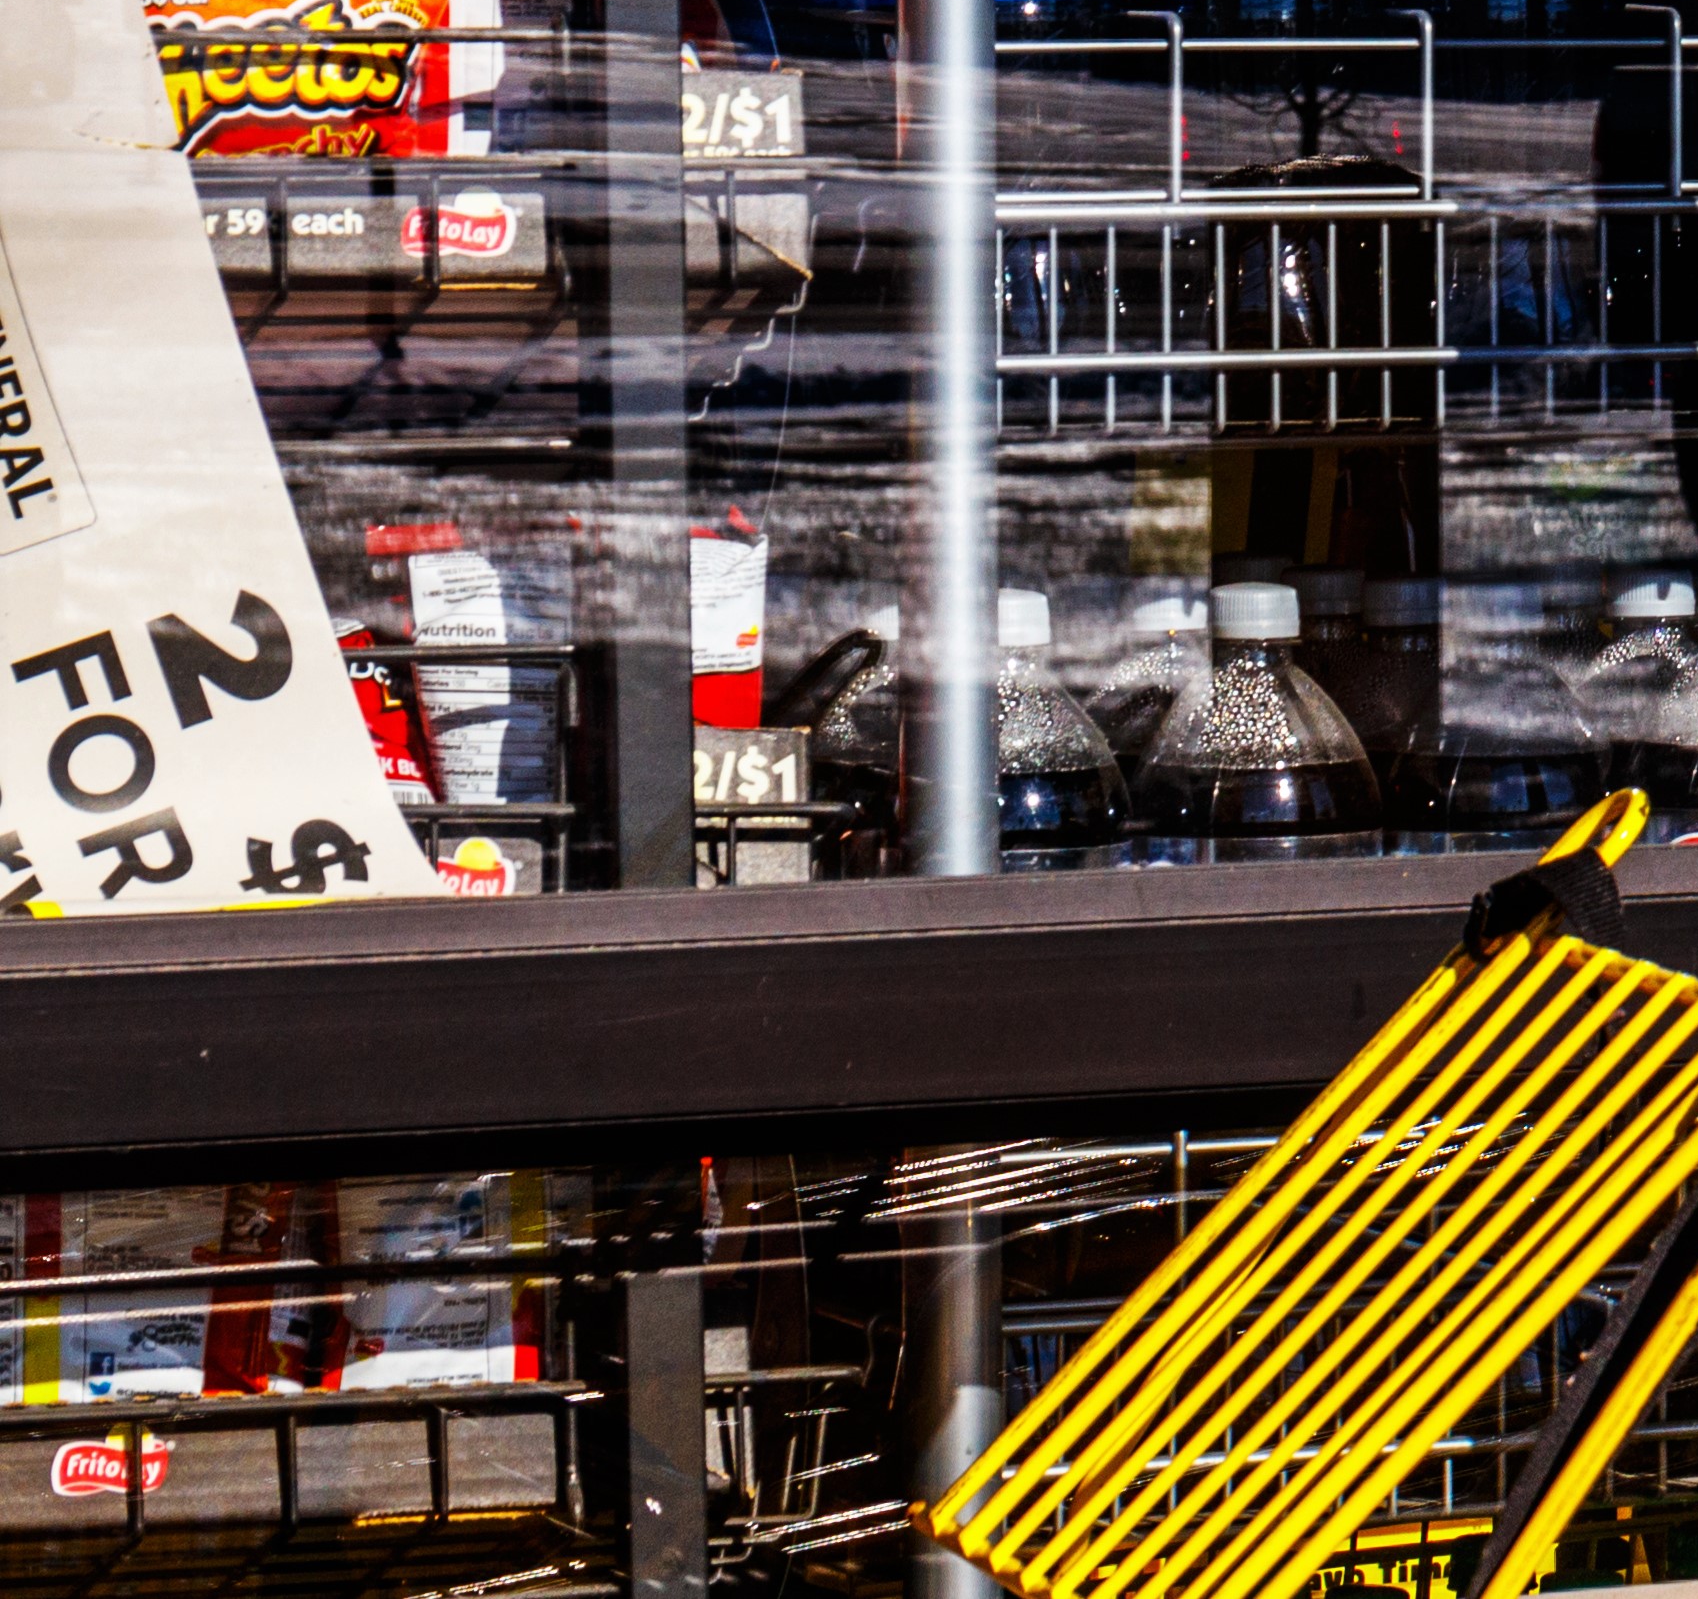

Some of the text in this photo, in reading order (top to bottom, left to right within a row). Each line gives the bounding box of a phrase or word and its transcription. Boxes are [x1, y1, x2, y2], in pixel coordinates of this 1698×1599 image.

[682, 87, 792, 148] 2/$1
[292, 198, 364, 225] each
[145, 589, 293, 729] 2
[420, 623, 496, 638] Nutrition
[11, 630, 193, 900] FOR
[693, 746, 797, 803] 2/$1
